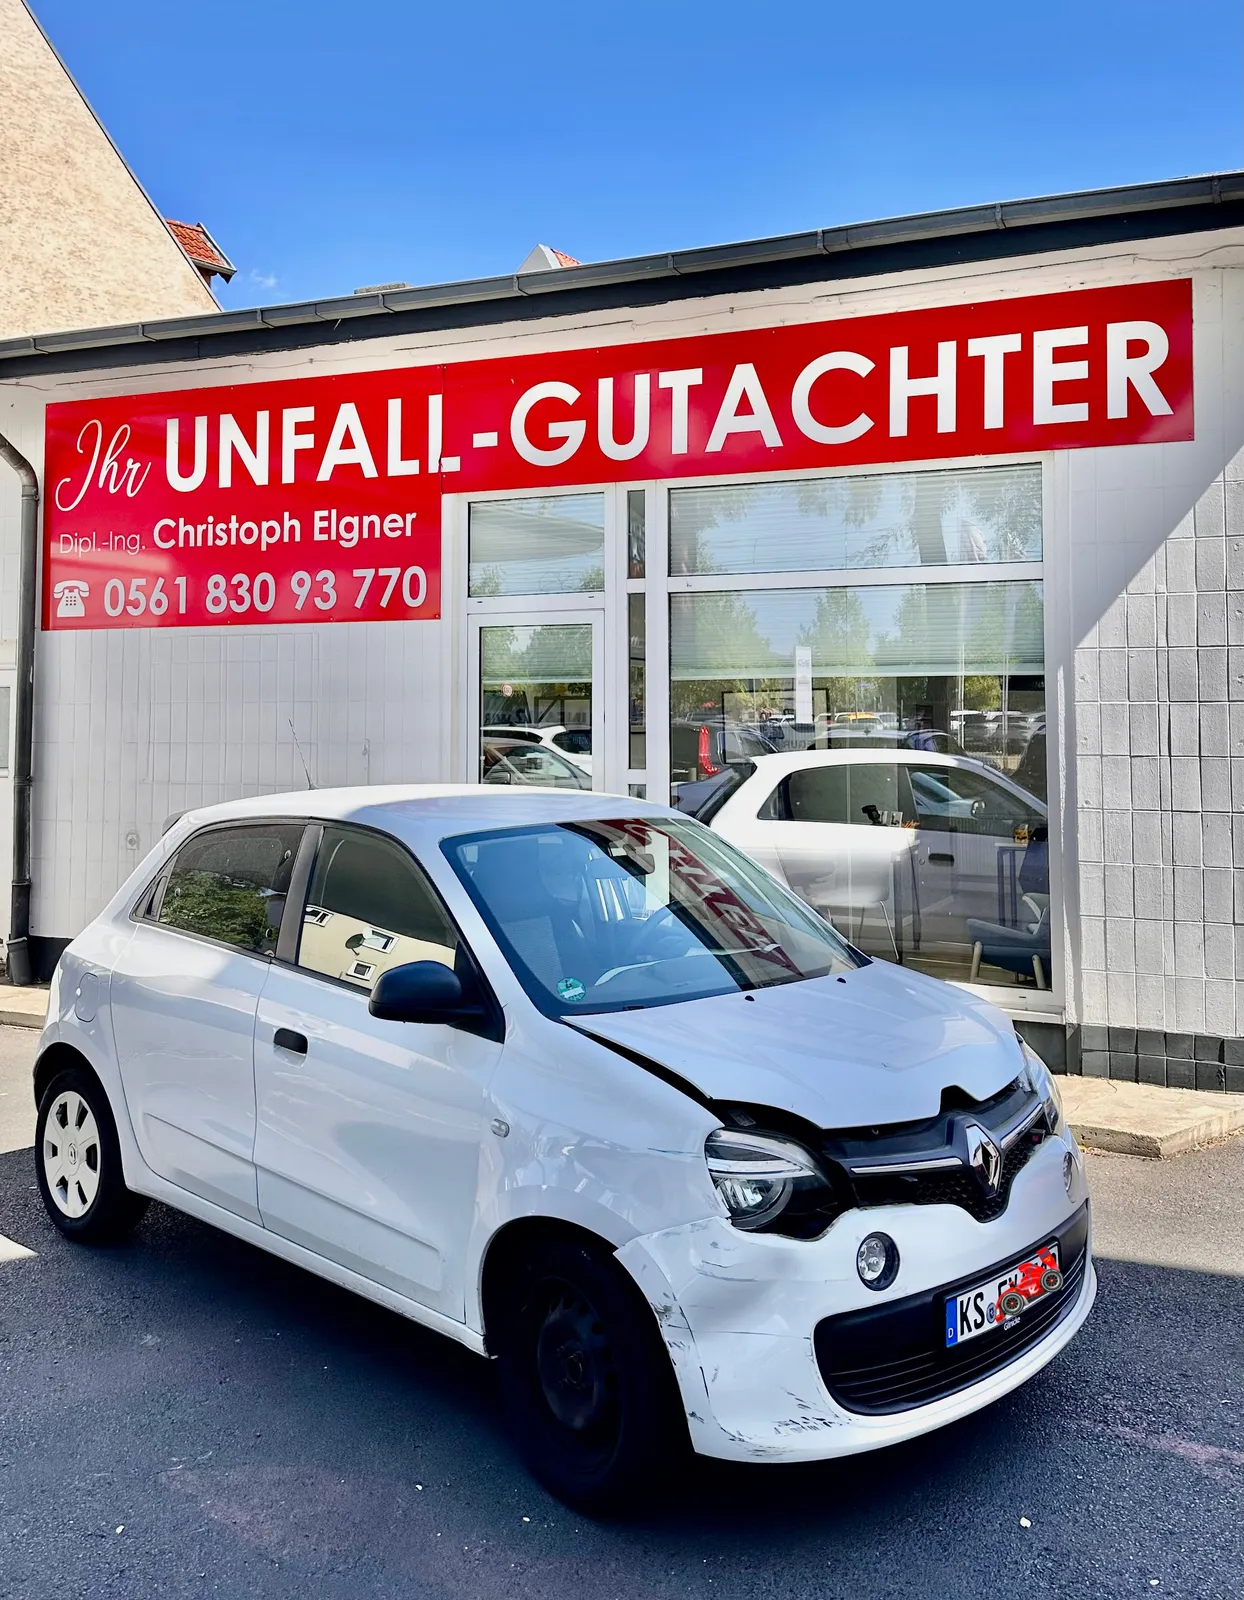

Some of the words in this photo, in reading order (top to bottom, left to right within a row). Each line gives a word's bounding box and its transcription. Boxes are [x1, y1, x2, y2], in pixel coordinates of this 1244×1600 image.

[56, 419, 152, 512] Ihr
[60, 530, 146, 557] Dipl.-Ing.
[153, 512, 301, 552] Christoph
[313, 509, 417, 548] Elgner
[104, 577, 187, 617] 0561
[205, 572, 276, 614] 830
[290, 570, 337, 611] 93
[352, 566, 427, 609] 770
[948, 1327, 954, 1339] D
[959, 1291, 986, 1336] KS
